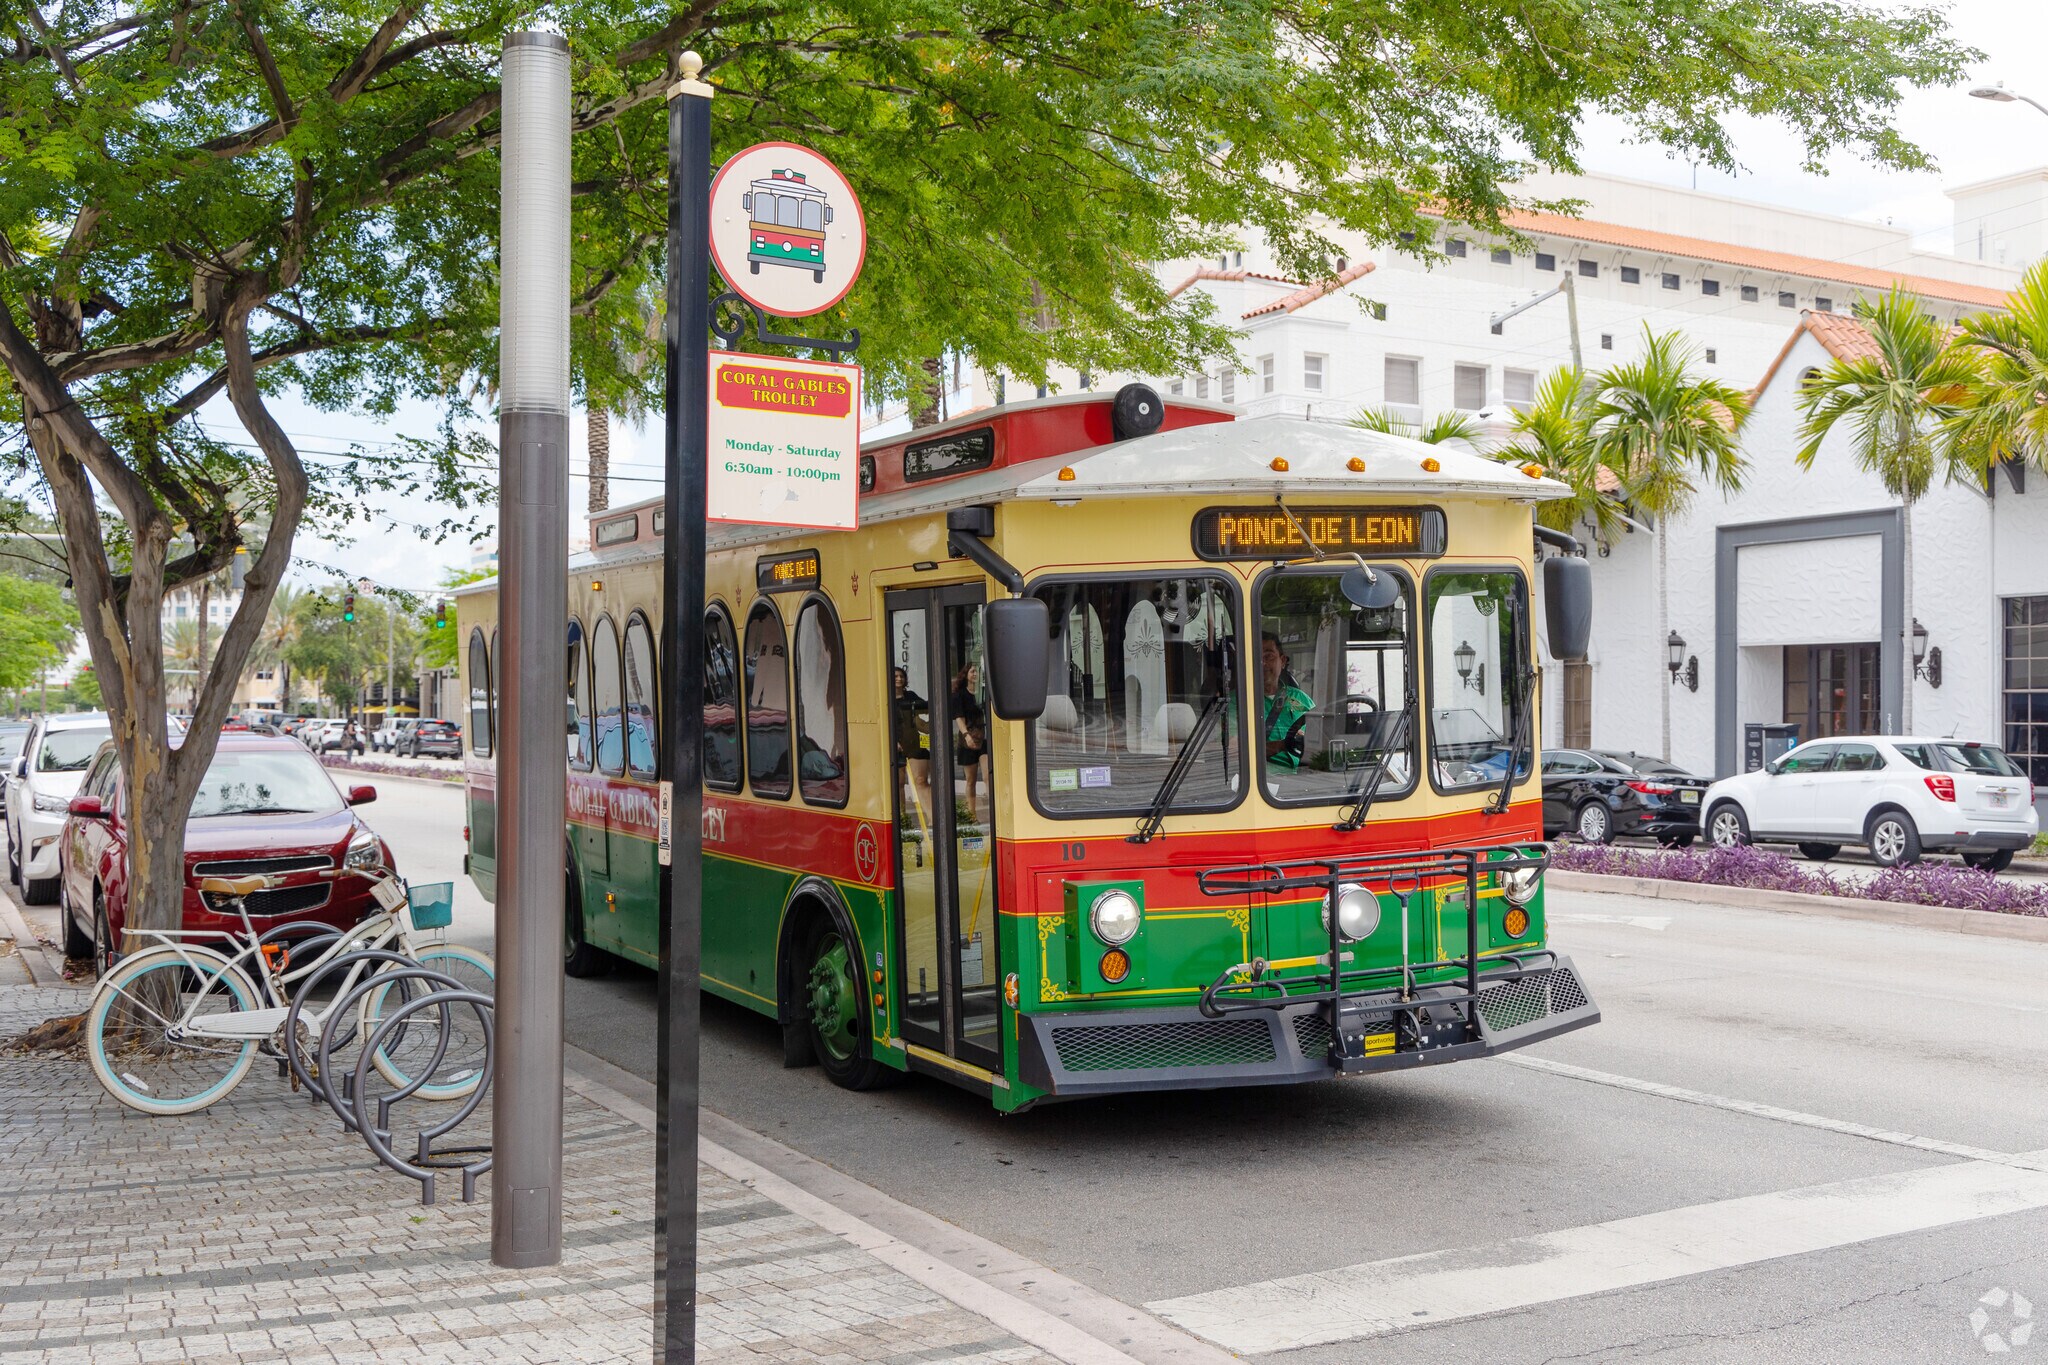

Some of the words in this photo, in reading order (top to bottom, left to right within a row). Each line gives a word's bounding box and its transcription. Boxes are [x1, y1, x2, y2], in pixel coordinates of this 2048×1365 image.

[722, 371, 778, 388] CORAL
[783, 377, 846, 395] GABLES
[751, 389, 818, 407] TROLLEY
[725, 439, 774, 455] Monday
[786, 444, 841, 461] Saturday
[725, 461, 773, 475] 6:30am
[786, 467, 841, 482] 10:00pm
[1219, 518, 1302, 545] PONCE
[1311, 517, 1342, 544] DE
[1351, 517, 1412, 543] LEON
[609, 790, 659, 829] GABLES
[1062, 842, 1086, 861] 10
[1366, 1036, 1394, 1046] sportworks
